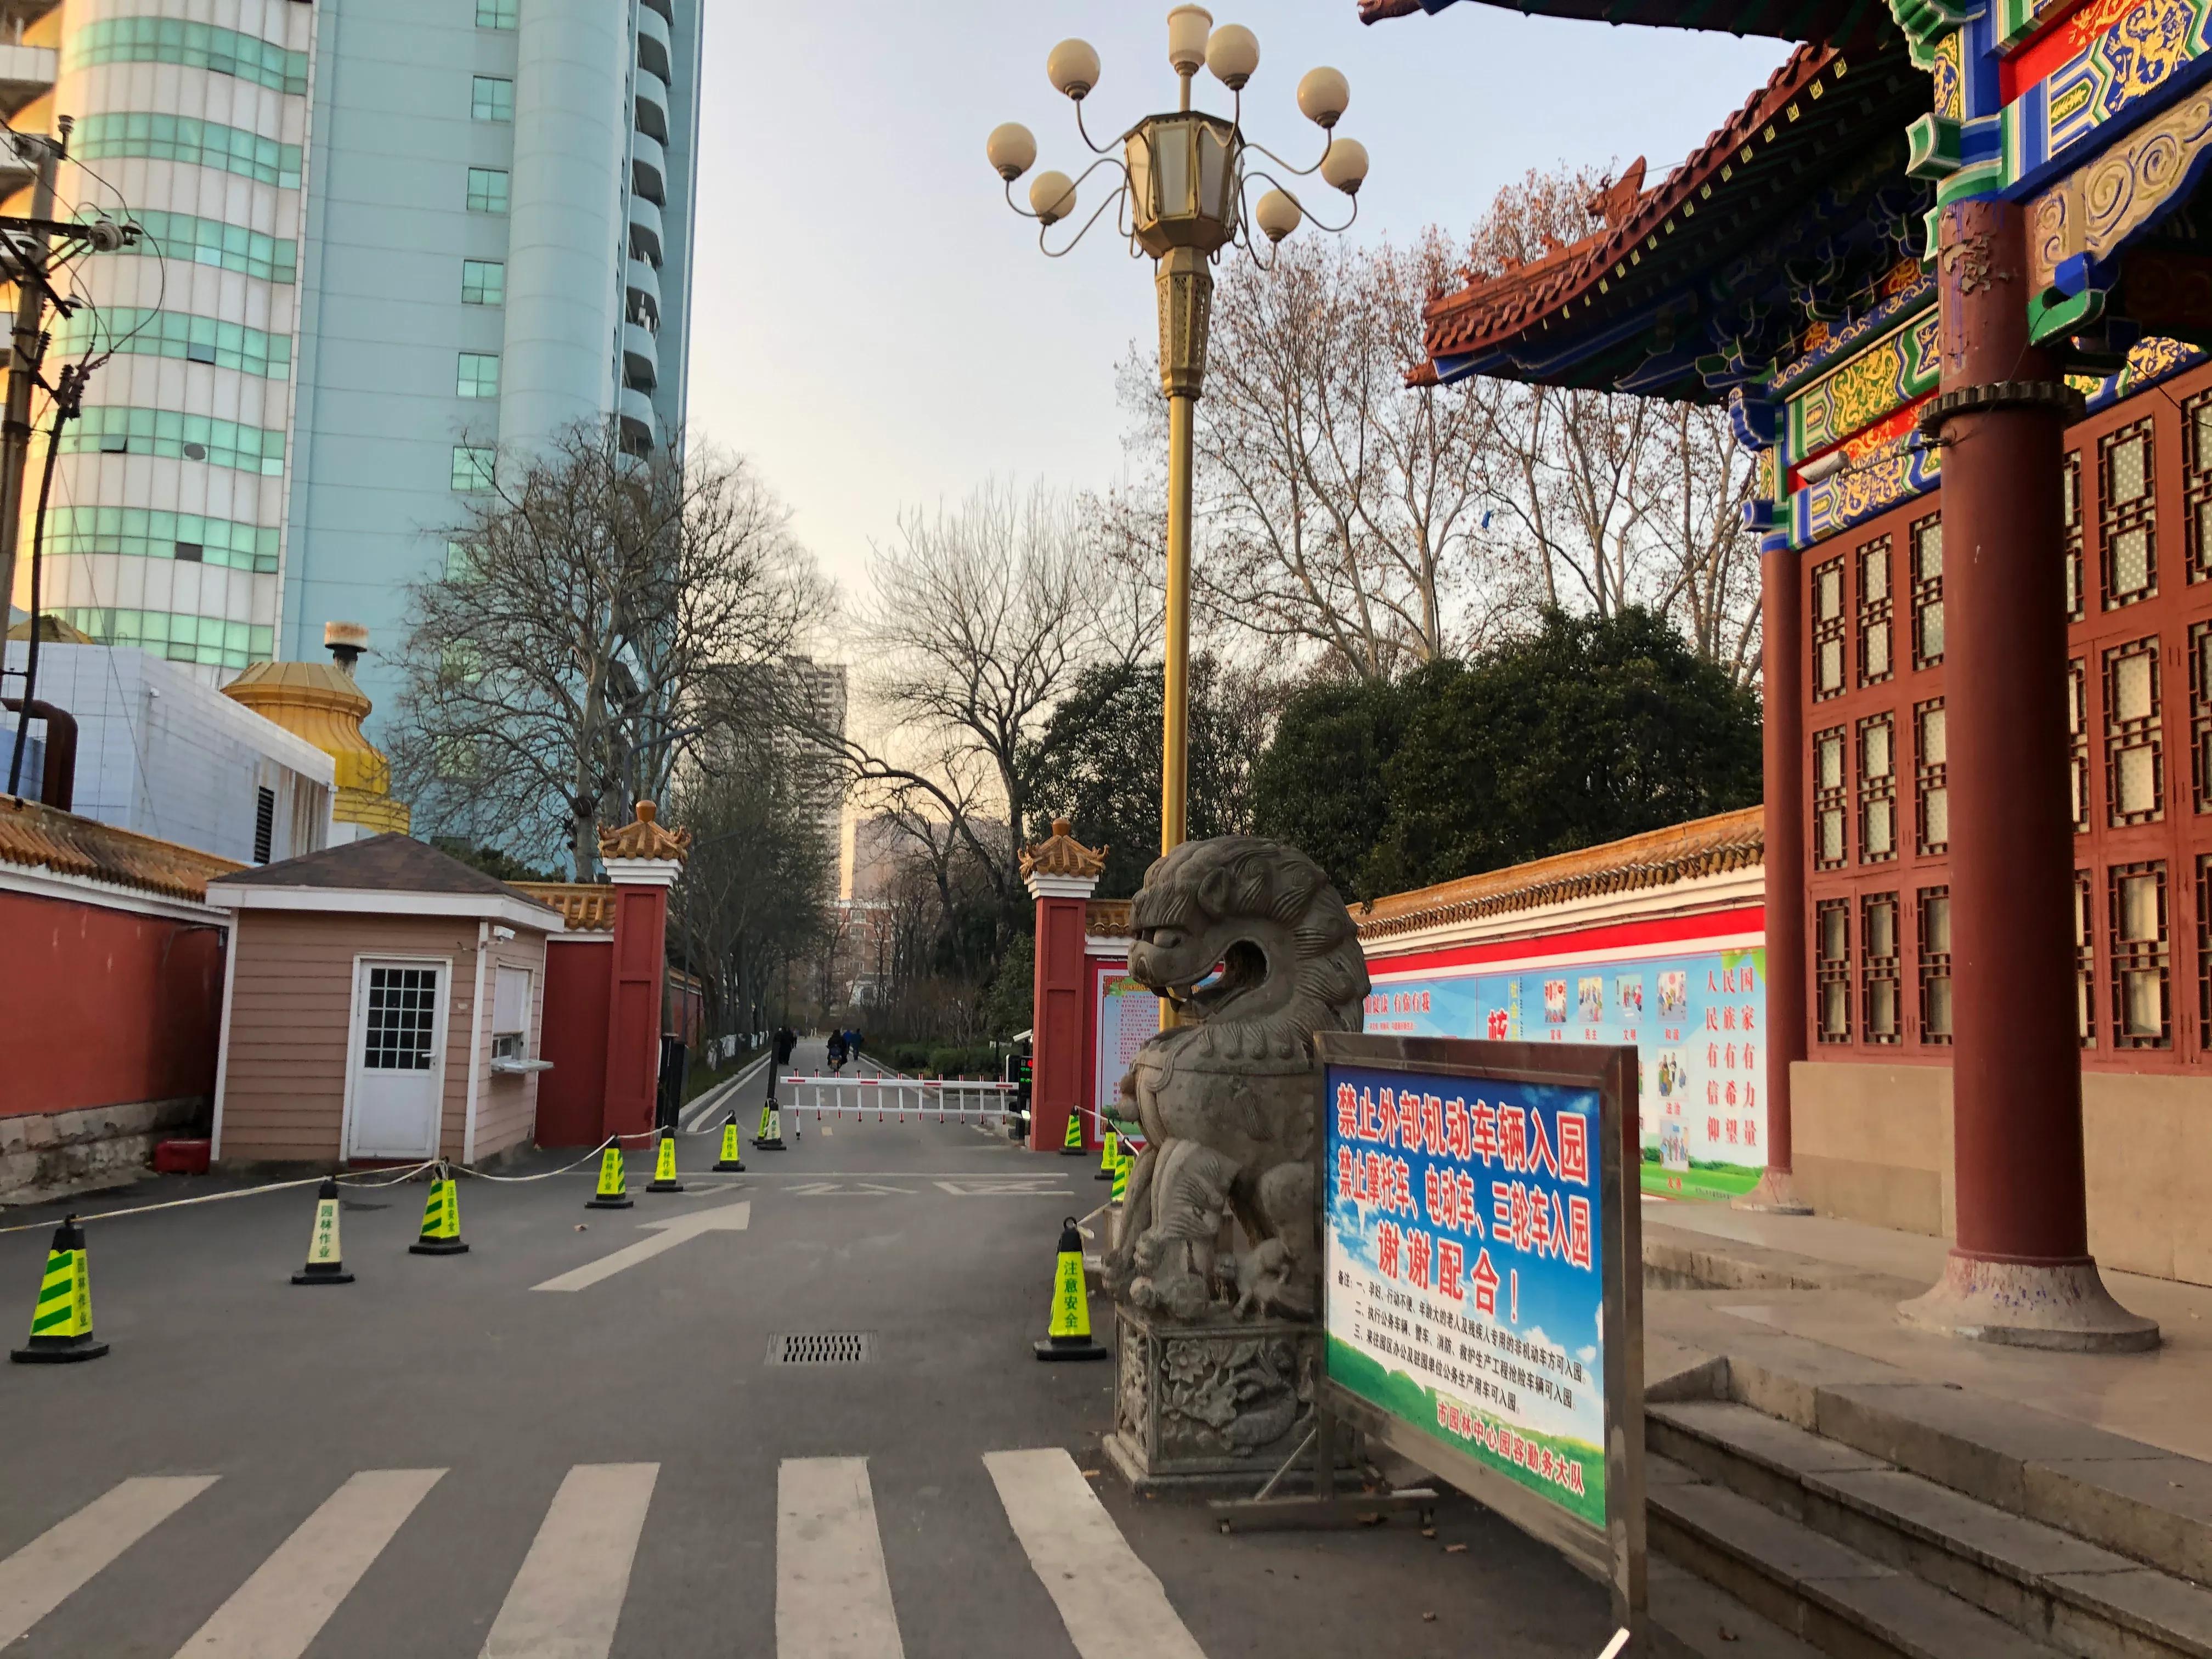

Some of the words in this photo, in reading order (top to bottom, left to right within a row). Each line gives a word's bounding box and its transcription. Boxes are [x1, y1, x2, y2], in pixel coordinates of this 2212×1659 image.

[1585, 1028, 1597, 1040] 民主
[1622, 1028, 1637, 1041] 文明
[1664, 1028, 1680, 1041] 和谐
[1706, 970, 1720, 1142] 人民有信仰
[1723, 968, 1739, 1144] 民族有希望
[1740, 967, 1756, 1146] 国家有力量
[1338, 1083, 1588, 1185] 禁止外部机动车辆入园
[319, 1205, 333, 1258] 园林作业
[1338, 1145, 1590, 1269] 禁止摩托车、电动车、三轮车入园
[1064, 1260, 1079, 1328] 注意安全
[1437, 1401, 1585, 1498] 市园林中心园容勤务大队
